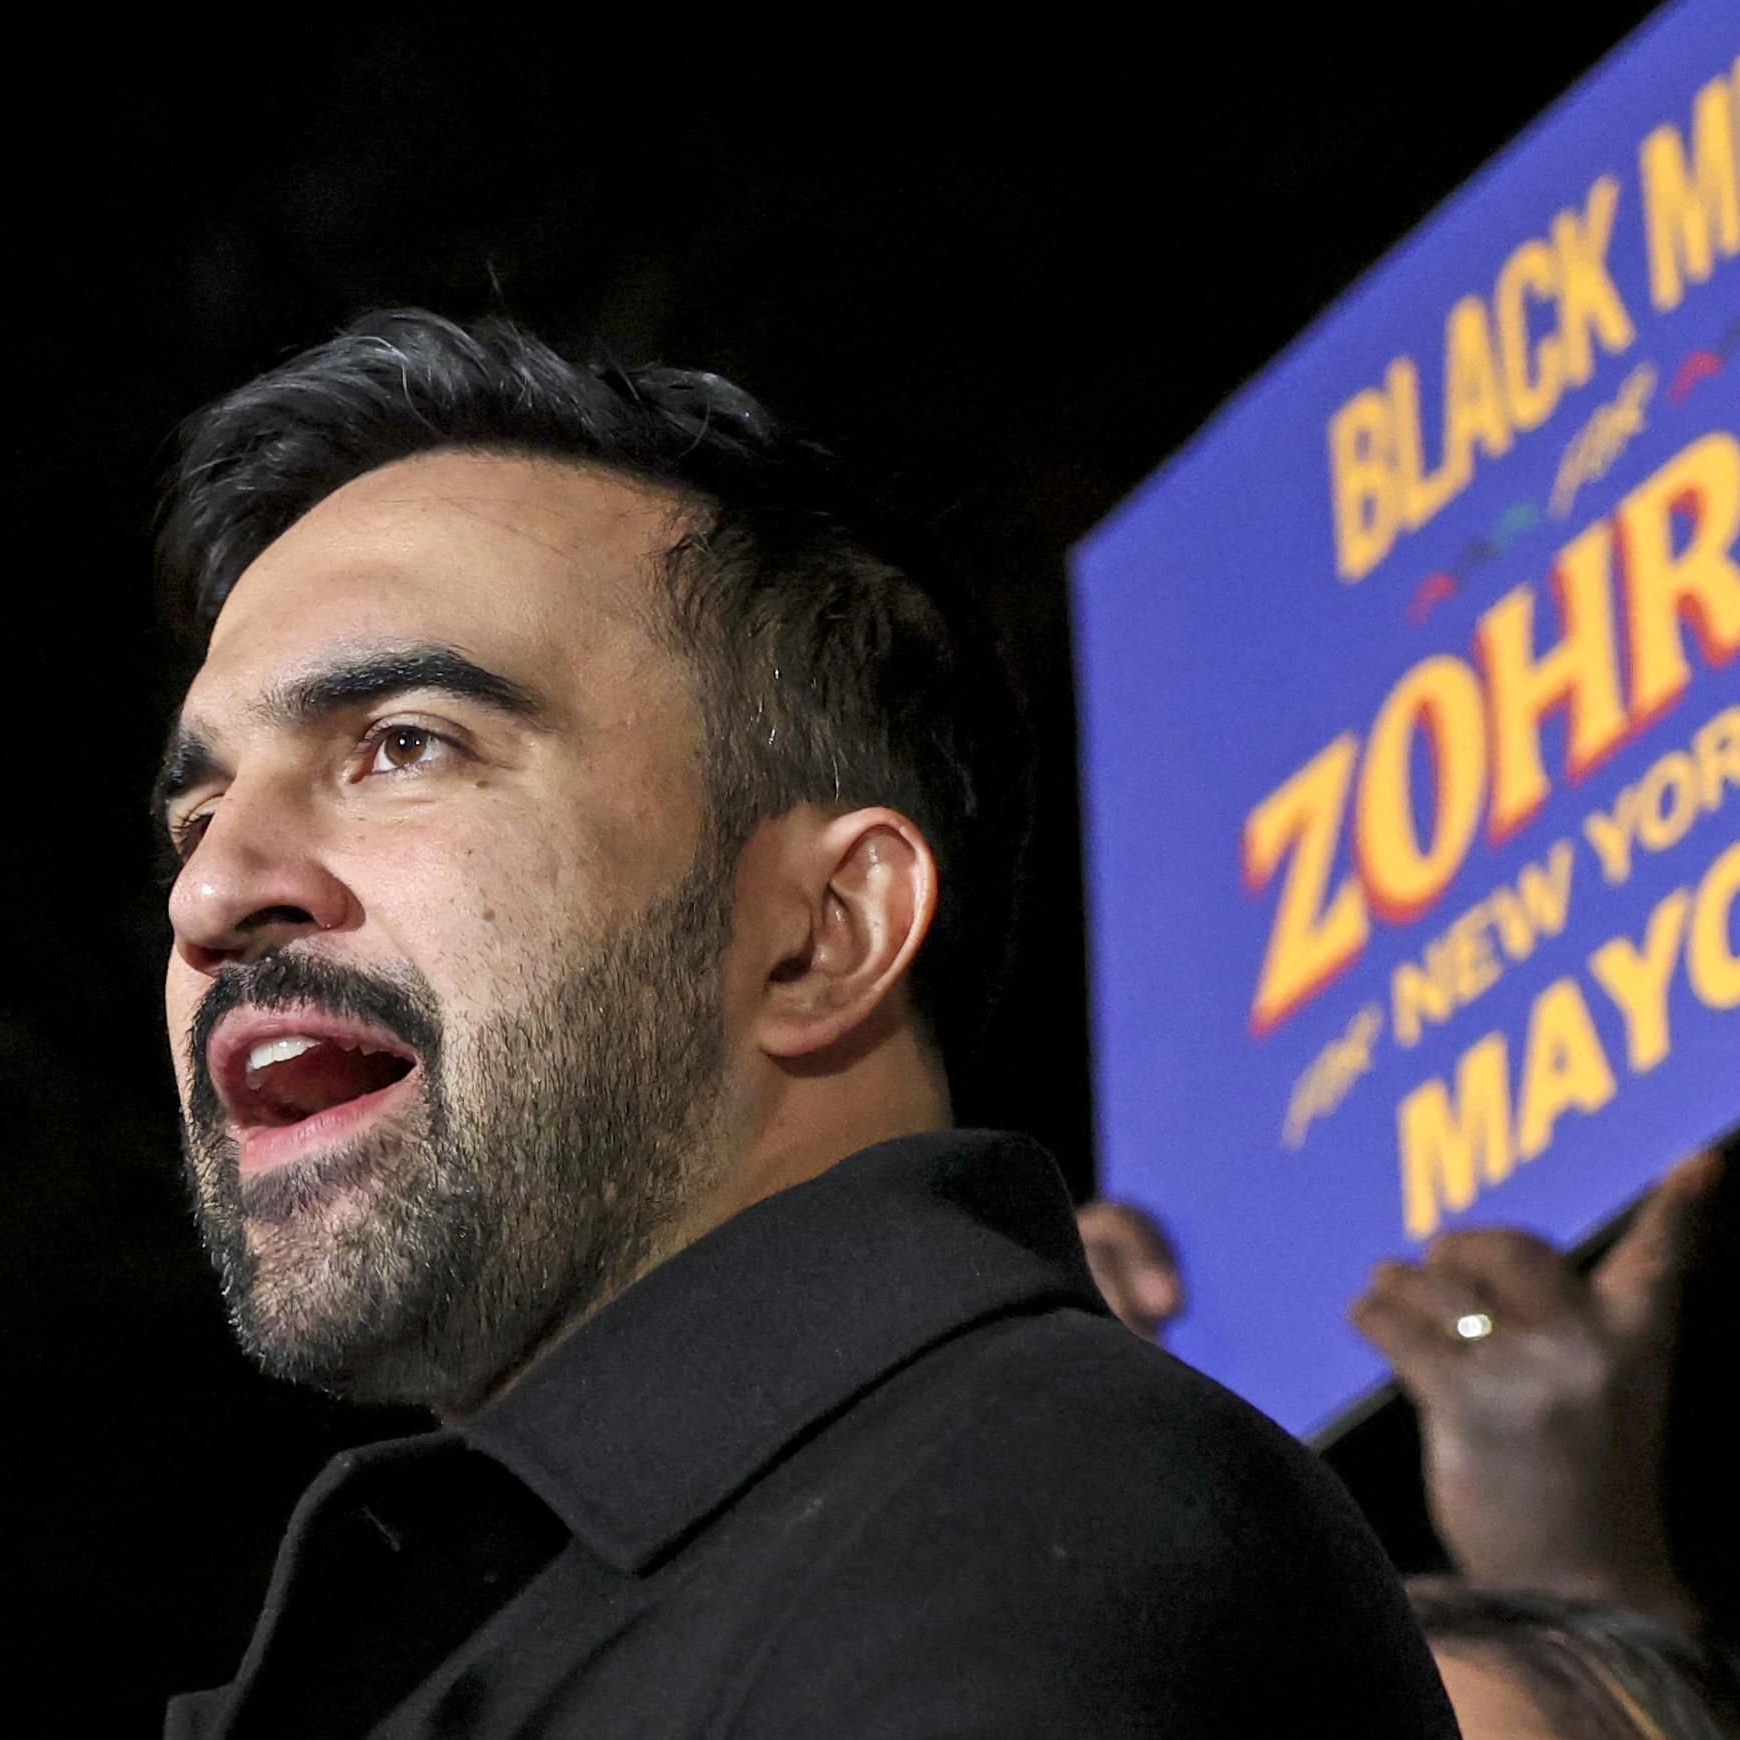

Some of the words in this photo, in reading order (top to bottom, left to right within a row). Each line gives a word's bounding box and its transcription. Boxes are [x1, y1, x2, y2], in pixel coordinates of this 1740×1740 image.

[1327, 172, 1637, 586] BLACK
[1640, 55, 1740, 313] M
[1240, 432, 1740, 1043] ZOHR
[1392, 839, 1575, 1048] NEW
